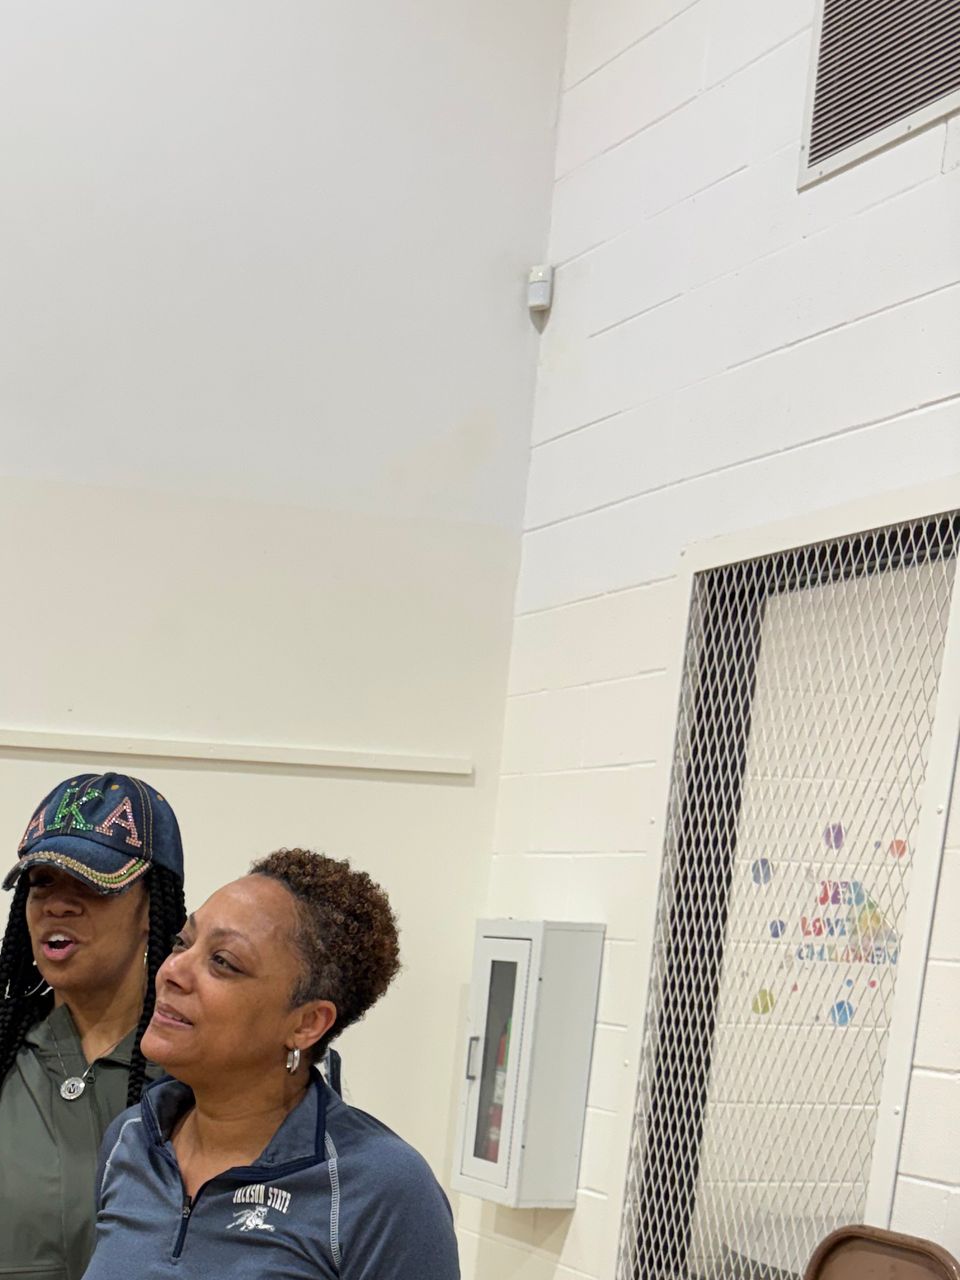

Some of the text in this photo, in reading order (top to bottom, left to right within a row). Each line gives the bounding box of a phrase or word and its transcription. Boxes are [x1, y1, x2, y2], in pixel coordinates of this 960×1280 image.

[18, 787, 142, 850] AKA
[233, 1184, 292, 1214] JACKSON STATE
